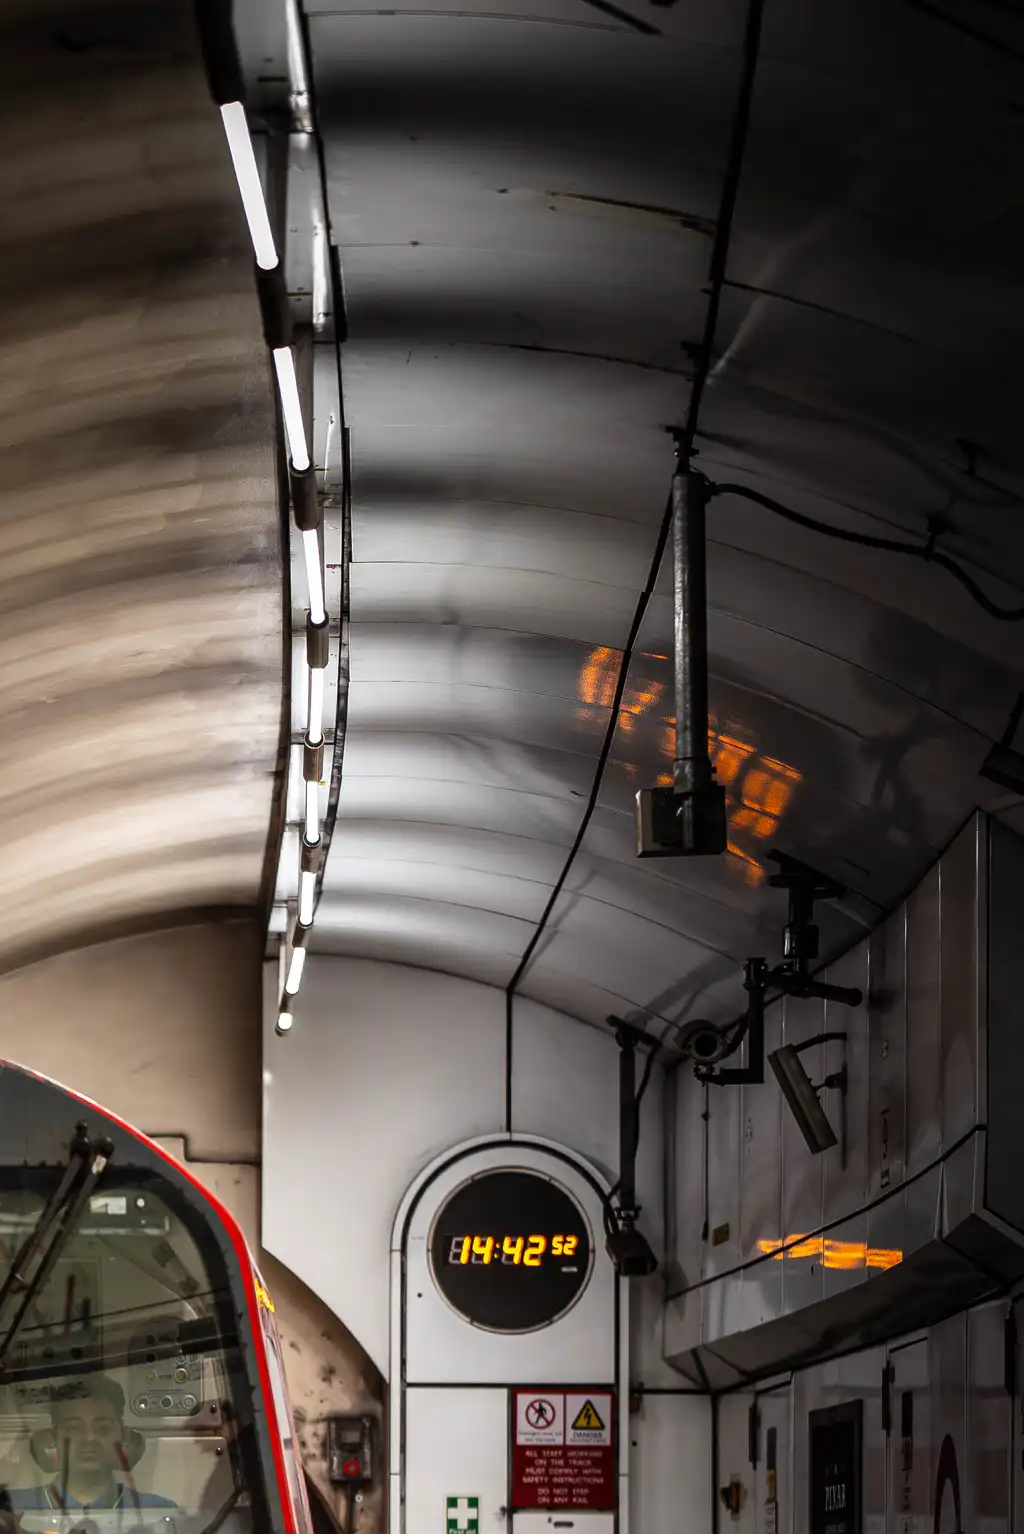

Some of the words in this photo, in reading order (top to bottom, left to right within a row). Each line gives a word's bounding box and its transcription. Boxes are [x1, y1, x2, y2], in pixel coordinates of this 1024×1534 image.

[460, 1234, 547, 1267] 14:42
[551, 1233, 579, 1256] 52
[525, 1450, 538, 1458] ALL
[534, 1459, 547, 1467] ON
[550, 1459, 564, 1467] THE
[568, 1459, 592, 1467] TRACK
[525, 1467, 546, 1475] MUST
[582, 1467, 601, 1475] WITH
[522, 1476, 548, 1484] SAFETY
[552, 1476, 604, 1484] INSTRUCTIONS
[537, 1487, 549, 1495] DO
[553, 1487, 568, 1495] NOT
[537, 1496, 549, 1504] ON
[553, 1496, 568, 1504] ANY
[824, 1483, 847, 1512] PIXAR
